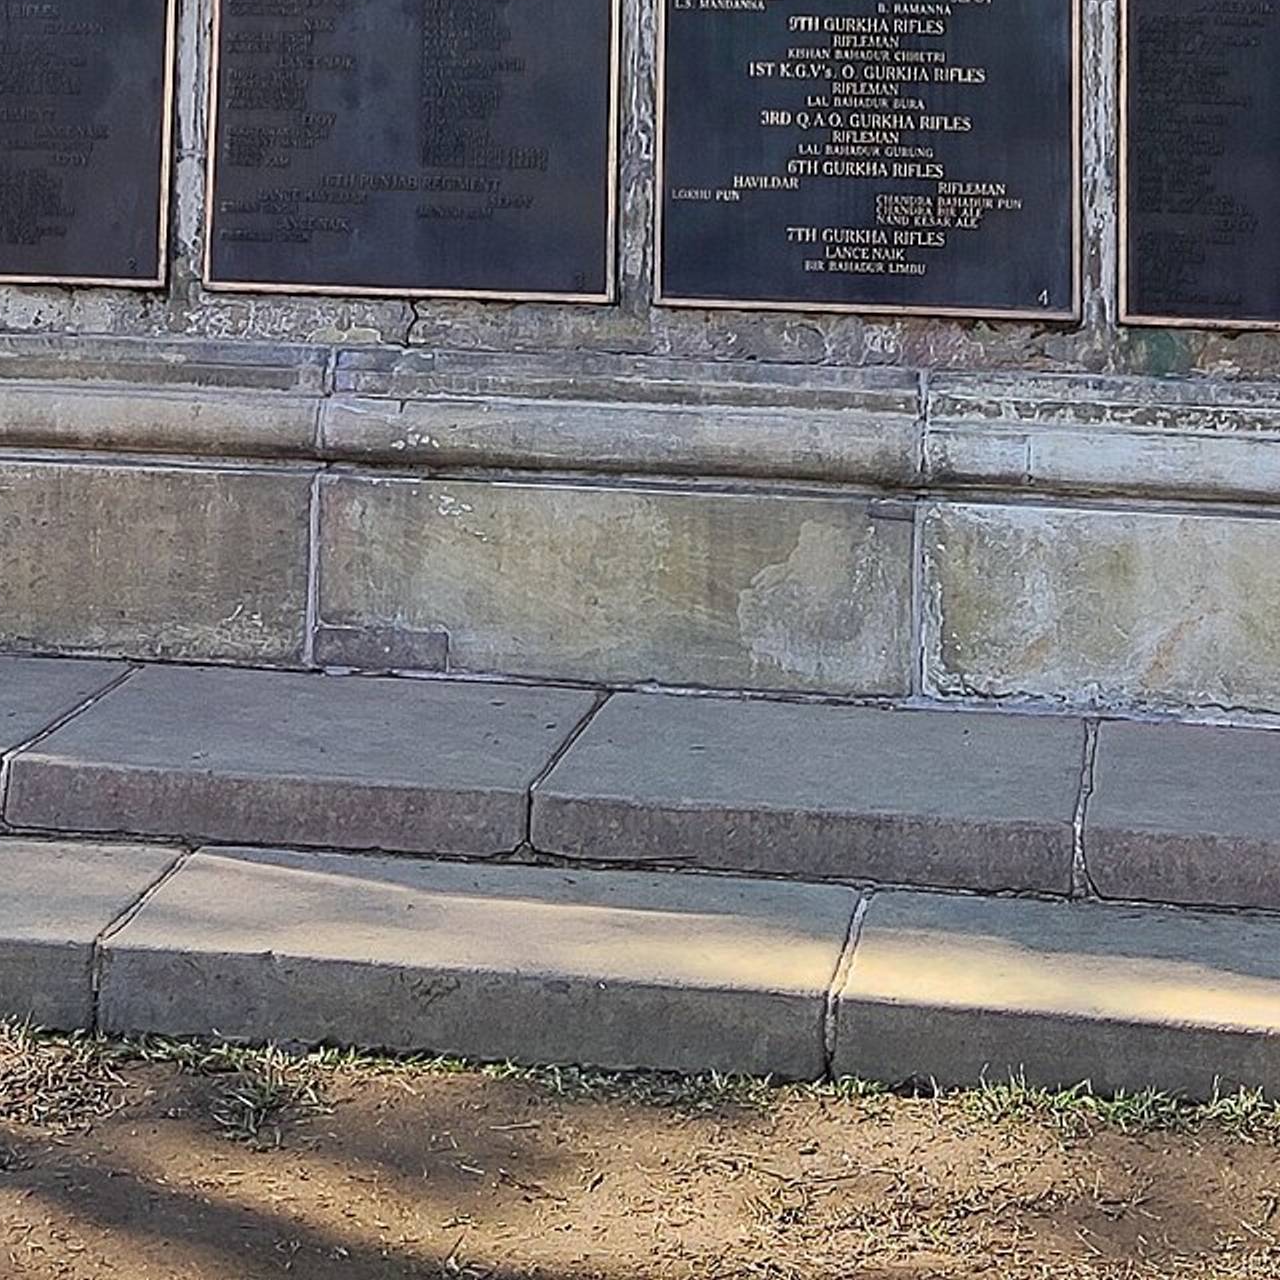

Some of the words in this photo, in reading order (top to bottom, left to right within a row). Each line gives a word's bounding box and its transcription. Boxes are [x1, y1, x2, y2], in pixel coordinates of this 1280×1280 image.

[788, 160, 818, 174] 6TH
[823, 162, 887, 176] GURKHA
[893, 163, 943, 178] RIFLES
[938, 182, 1005, 195] RIFLEMAN
